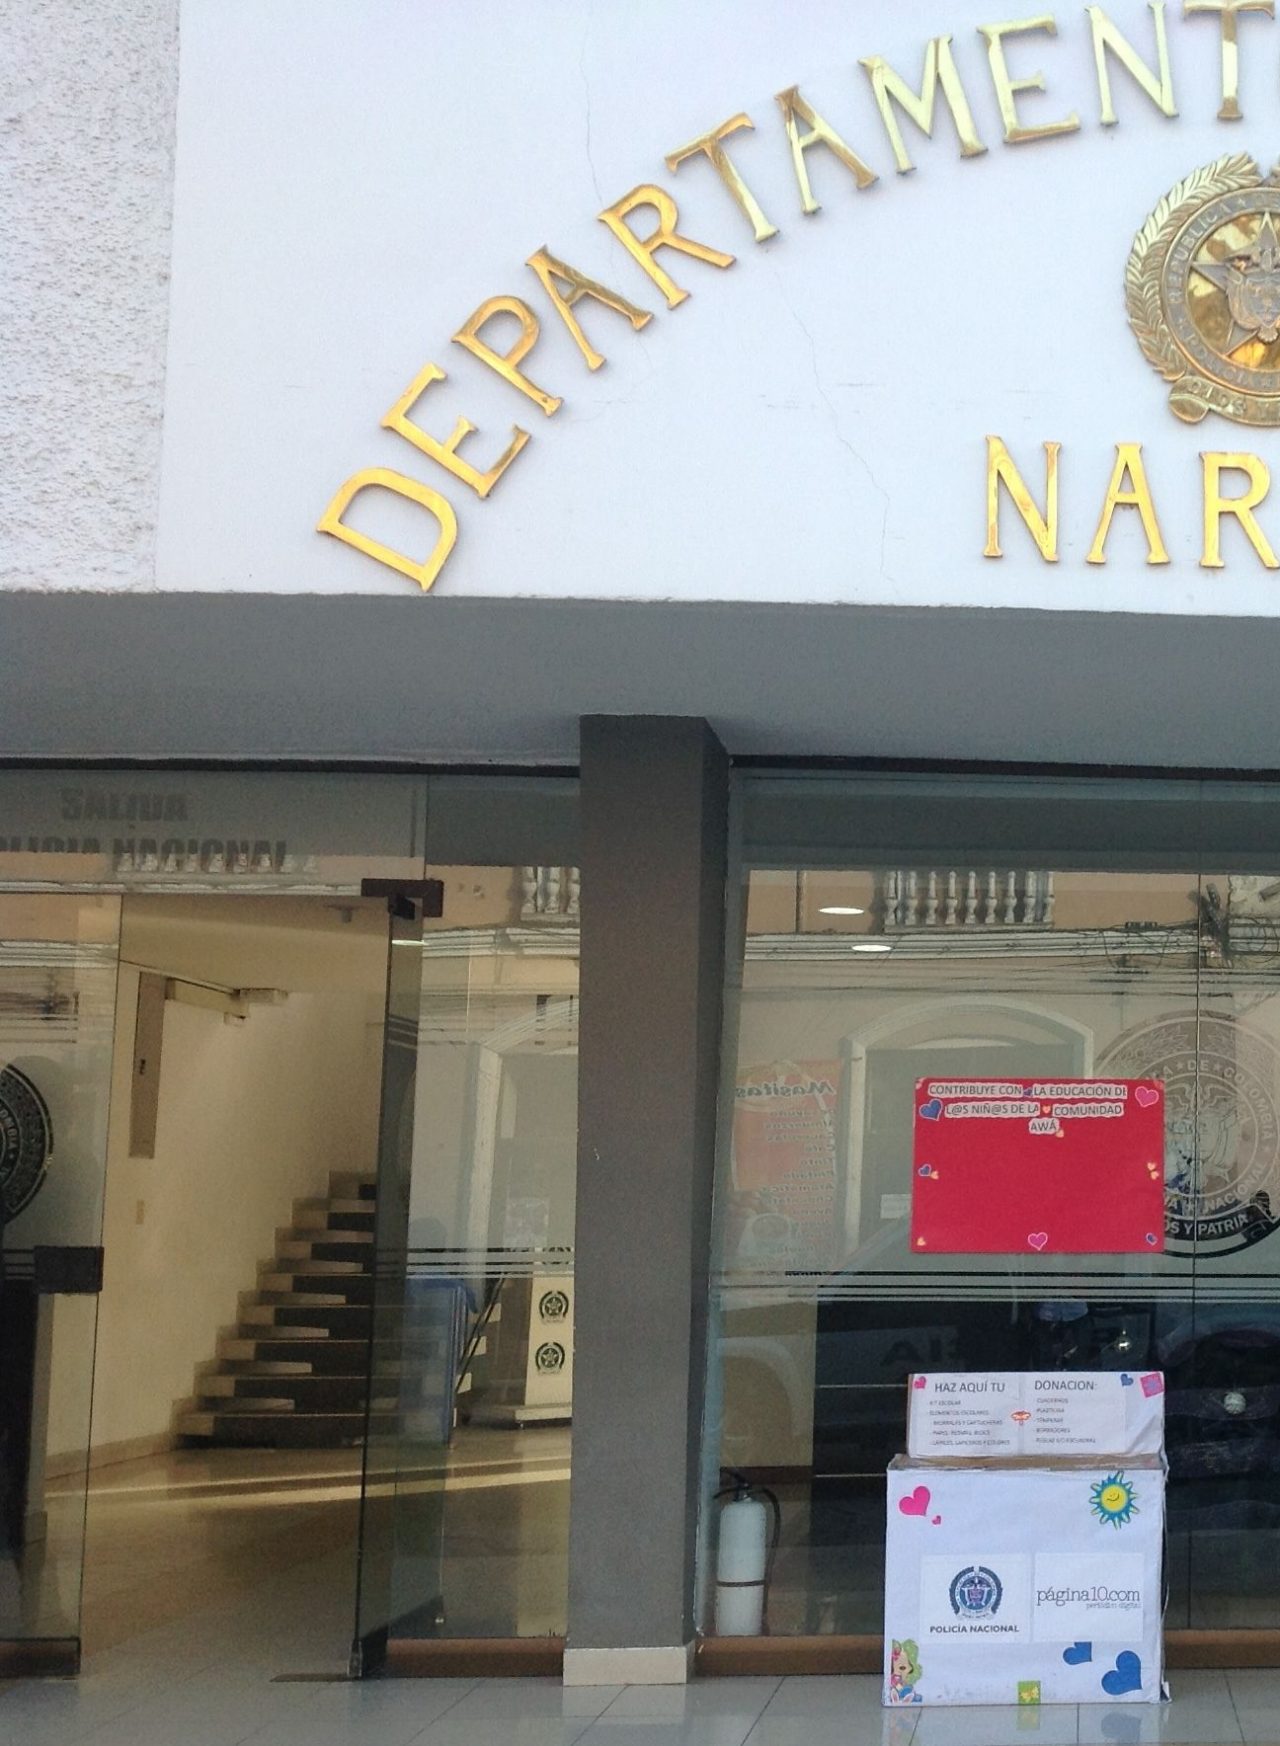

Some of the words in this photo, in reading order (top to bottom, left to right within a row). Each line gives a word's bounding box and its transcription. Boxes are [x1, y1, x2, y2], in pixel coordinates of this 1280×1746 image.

[61, 789, 189, 821] SALIDA
[1187, 1060, 1210, 1072] DE
[929, 1084, 995, 1095] CONTRIBUYE
[1000, 1085, 1022, 1095] CON
[1033, 1087, 1046, 1096] LA
[1012, 1103, 1025, 1114] DE
[1028, 1103, 1040, 1113] LA
[1054, 1103, 1122, 1116] COMUNIDAD
[1030, 1119, 1057, 1131] AWÁ
[1198, 1213, 1249, 1235] PATRIA
[935, 1382, 957, 1392] HAZ
[960, 1380, 987, 1393] AQUÍ
[991, 1383, 1005, 1392] TU
[1036, 1586, 1140, 1607] página10.com
[930, 1624, 968, 1634] POLICÍA
[970, 1624, 1020, 1633] NACIONAL
